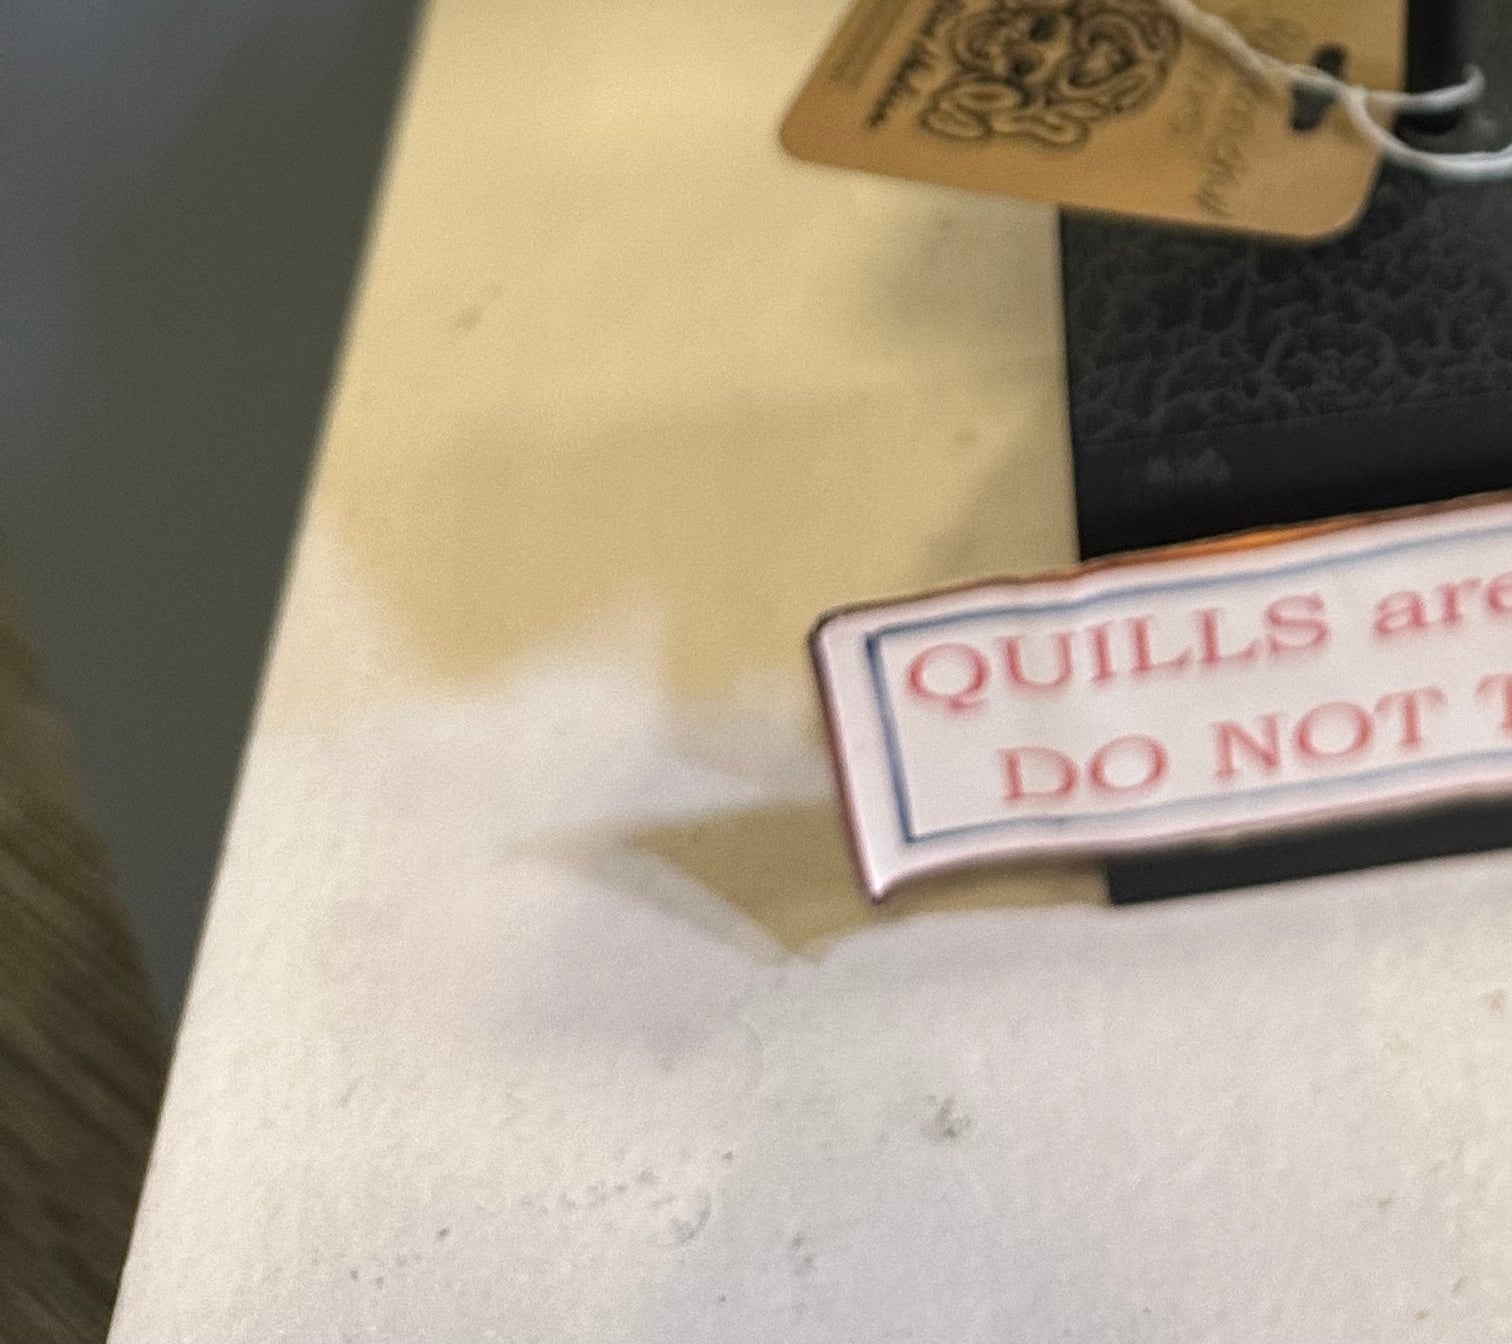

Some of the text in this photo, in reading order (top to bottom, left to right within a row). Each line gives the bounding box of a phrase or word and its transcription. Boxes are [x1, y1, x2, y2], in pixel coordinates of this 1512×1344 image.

[903, 592, 1333, 716] QUILLS
[998, 733, 1170, 805] DO
[1211, 684, 1447, 782] NOT
